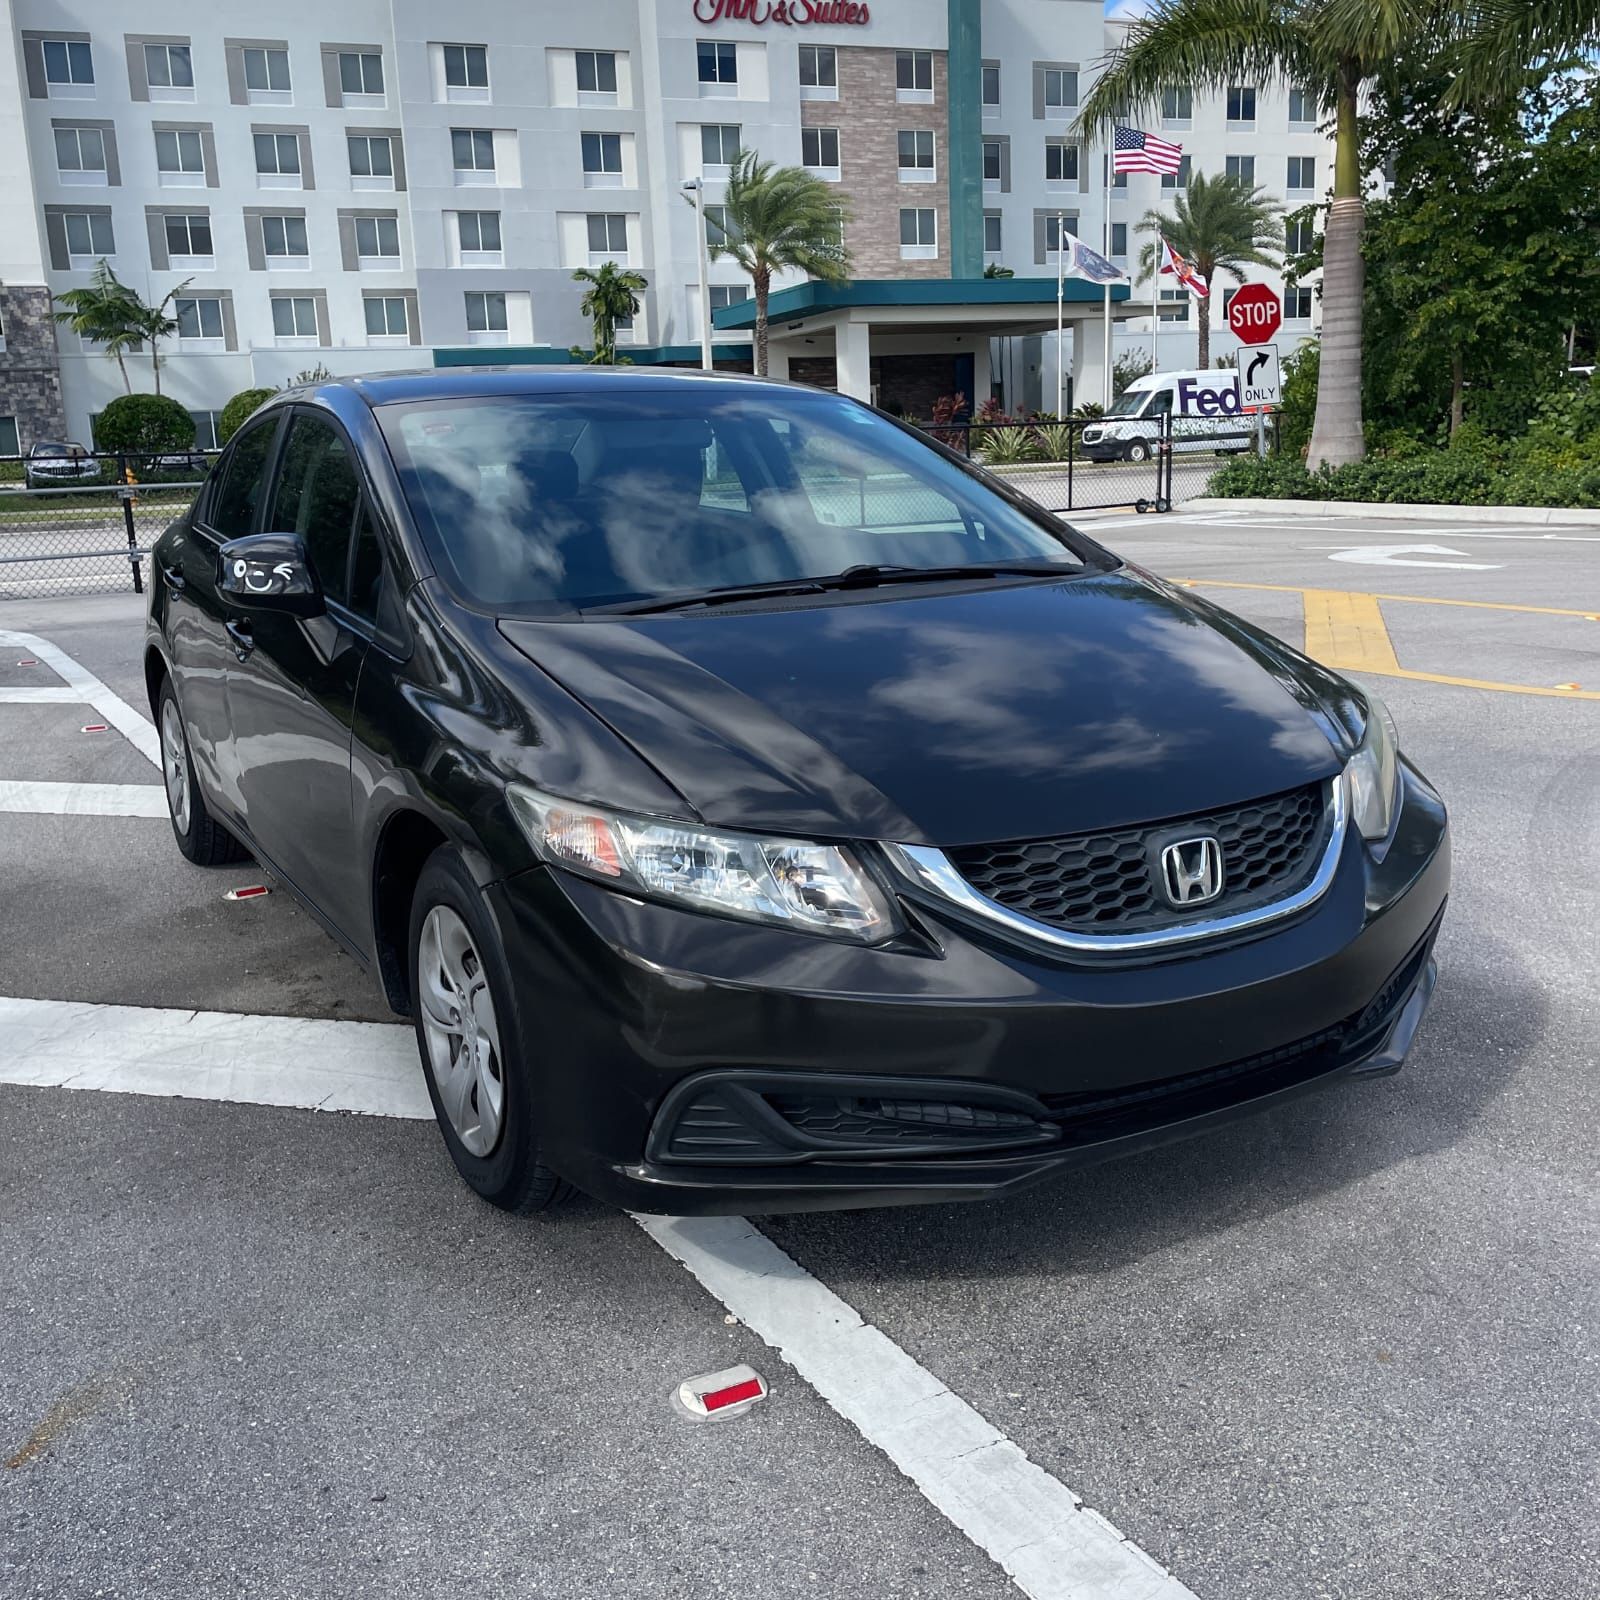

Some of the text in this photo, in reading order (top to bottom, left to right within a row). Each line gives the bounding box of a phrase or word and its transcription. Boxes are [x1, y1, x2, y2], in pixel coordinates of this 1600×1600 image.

[789, 0, 870, 24] Suites
[1232, 301, 1278, 328] STOP
[1177, 376, 1272, 416] Fed
[1245, 387, 1275, 401] ONLY
